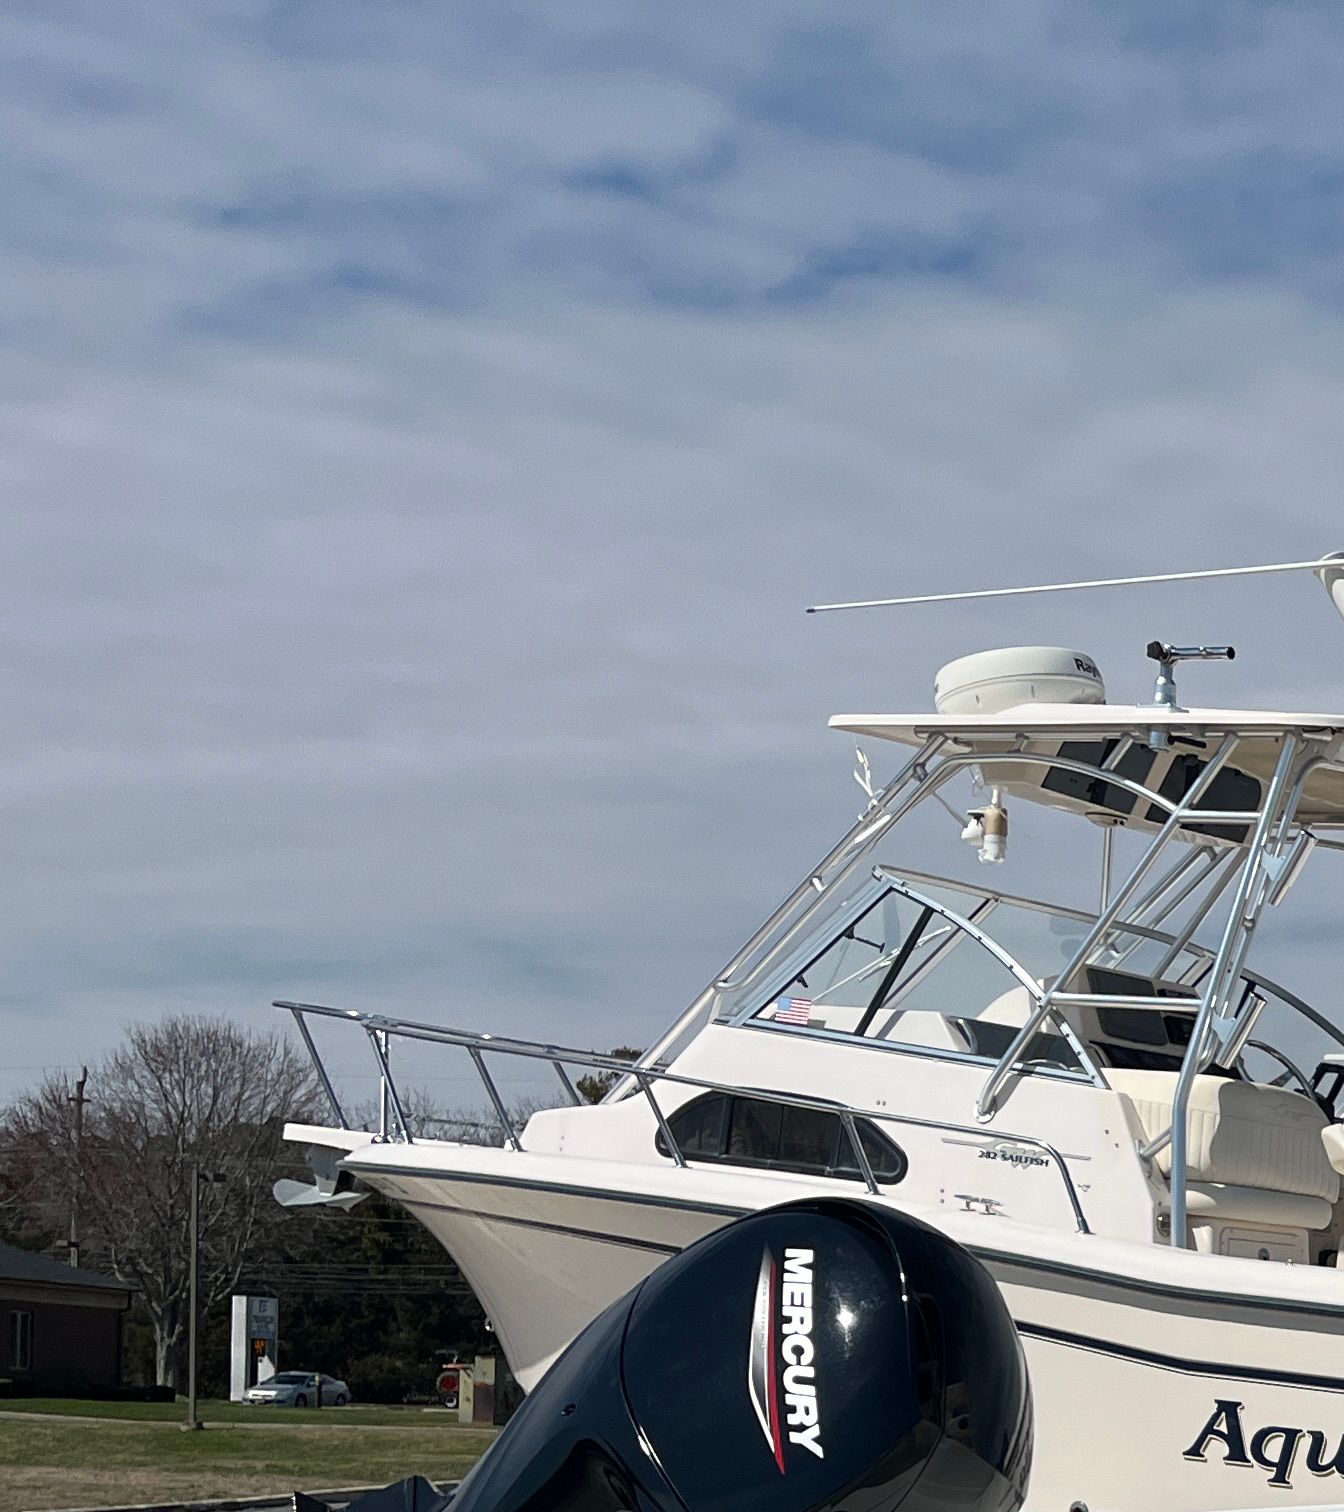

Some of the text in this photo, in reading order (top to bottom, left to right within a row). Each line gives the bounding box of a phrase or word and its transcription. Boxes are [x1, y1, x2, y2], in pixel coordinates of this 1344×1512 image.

[977, 1150, 1050, 1168] 282 SAILFISH
[781, 1248, 825, 1459] MERCURY
